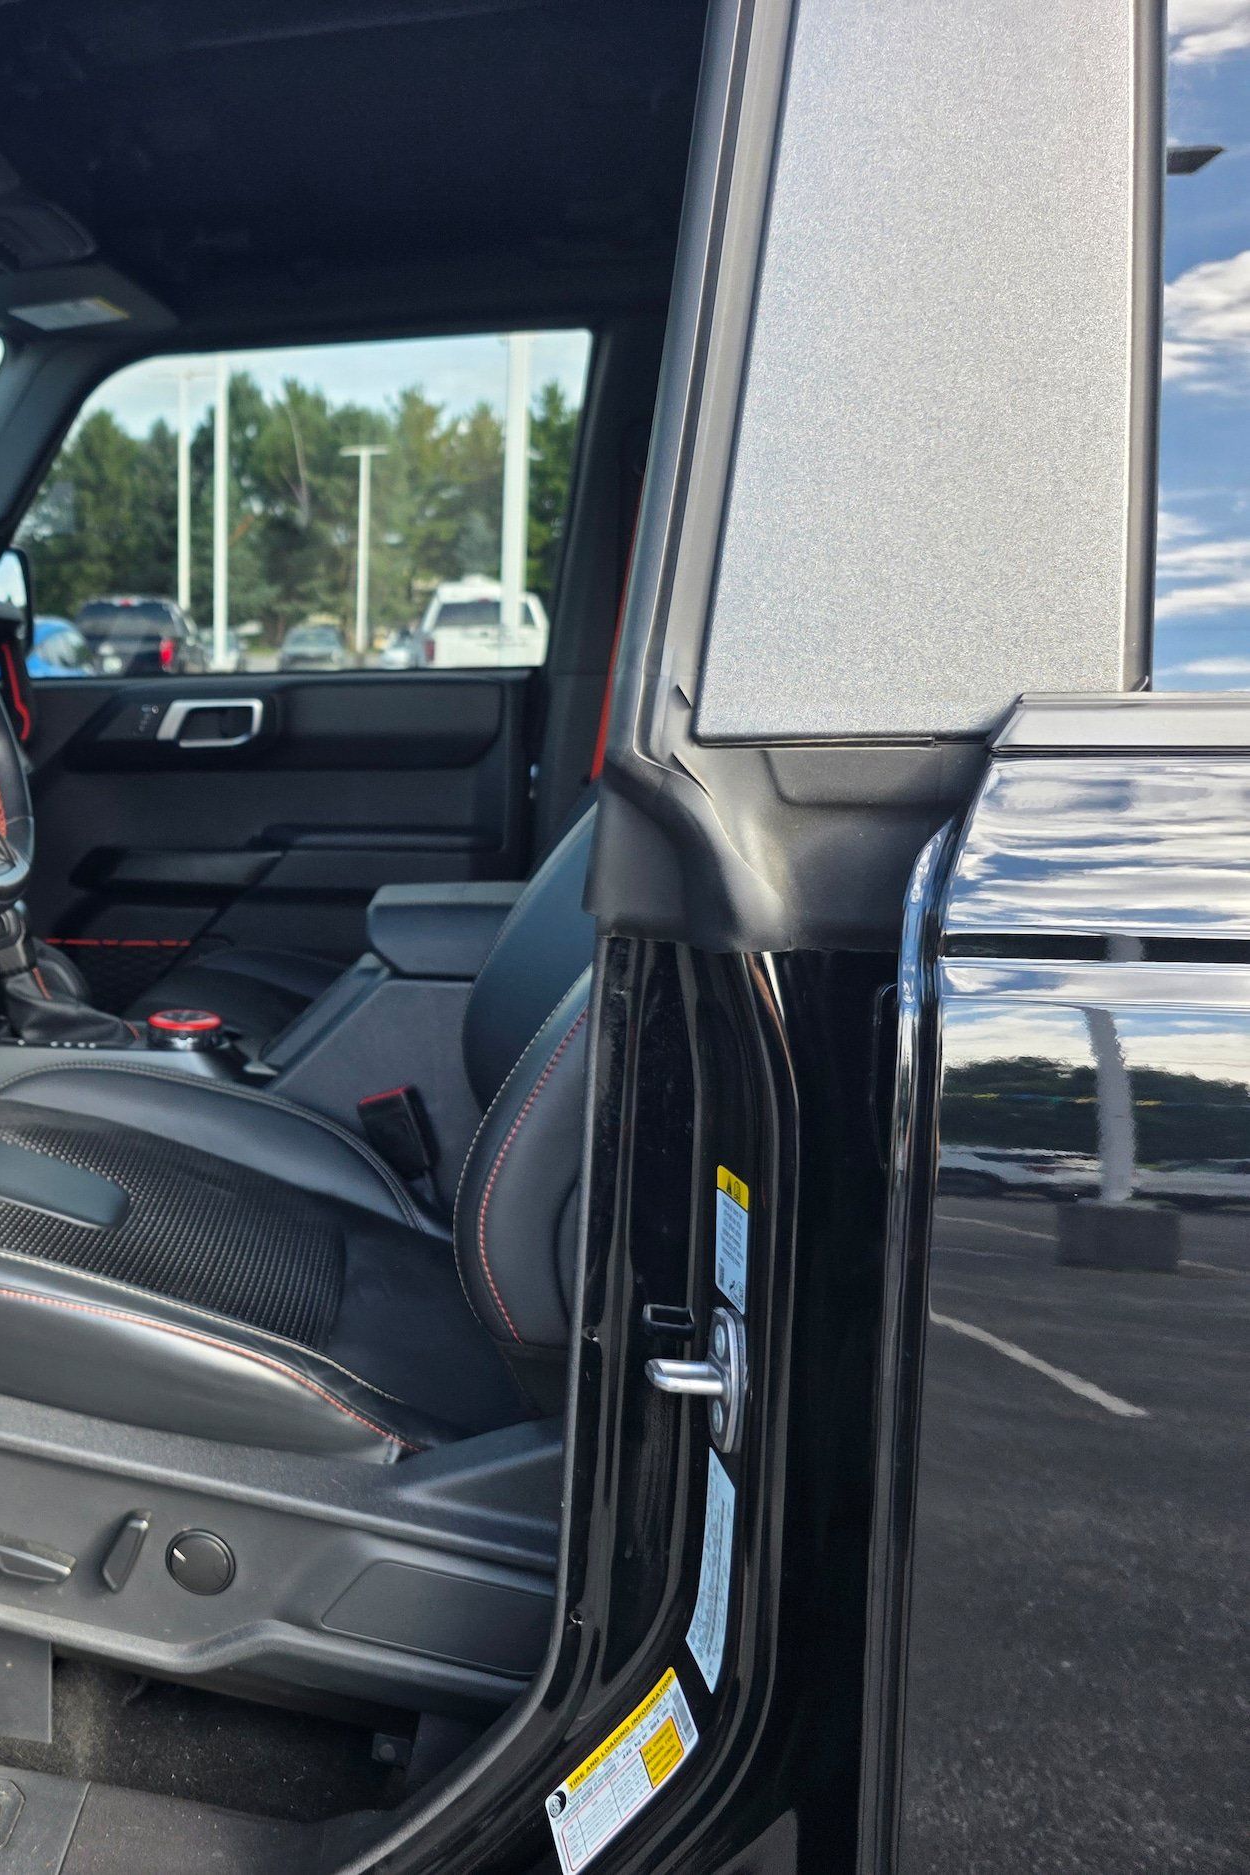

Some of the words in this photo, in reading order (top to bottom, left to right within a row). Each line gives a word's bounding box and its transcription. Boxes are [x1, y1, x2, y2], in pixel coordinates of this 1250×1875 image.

[568, 1769, 584, 1790] TIRE
[585, 1754, 600, 1773] AND
[599, 1723, 630, 1758] LOADING
[630, 1671, 672, 1726] INFORMATION
